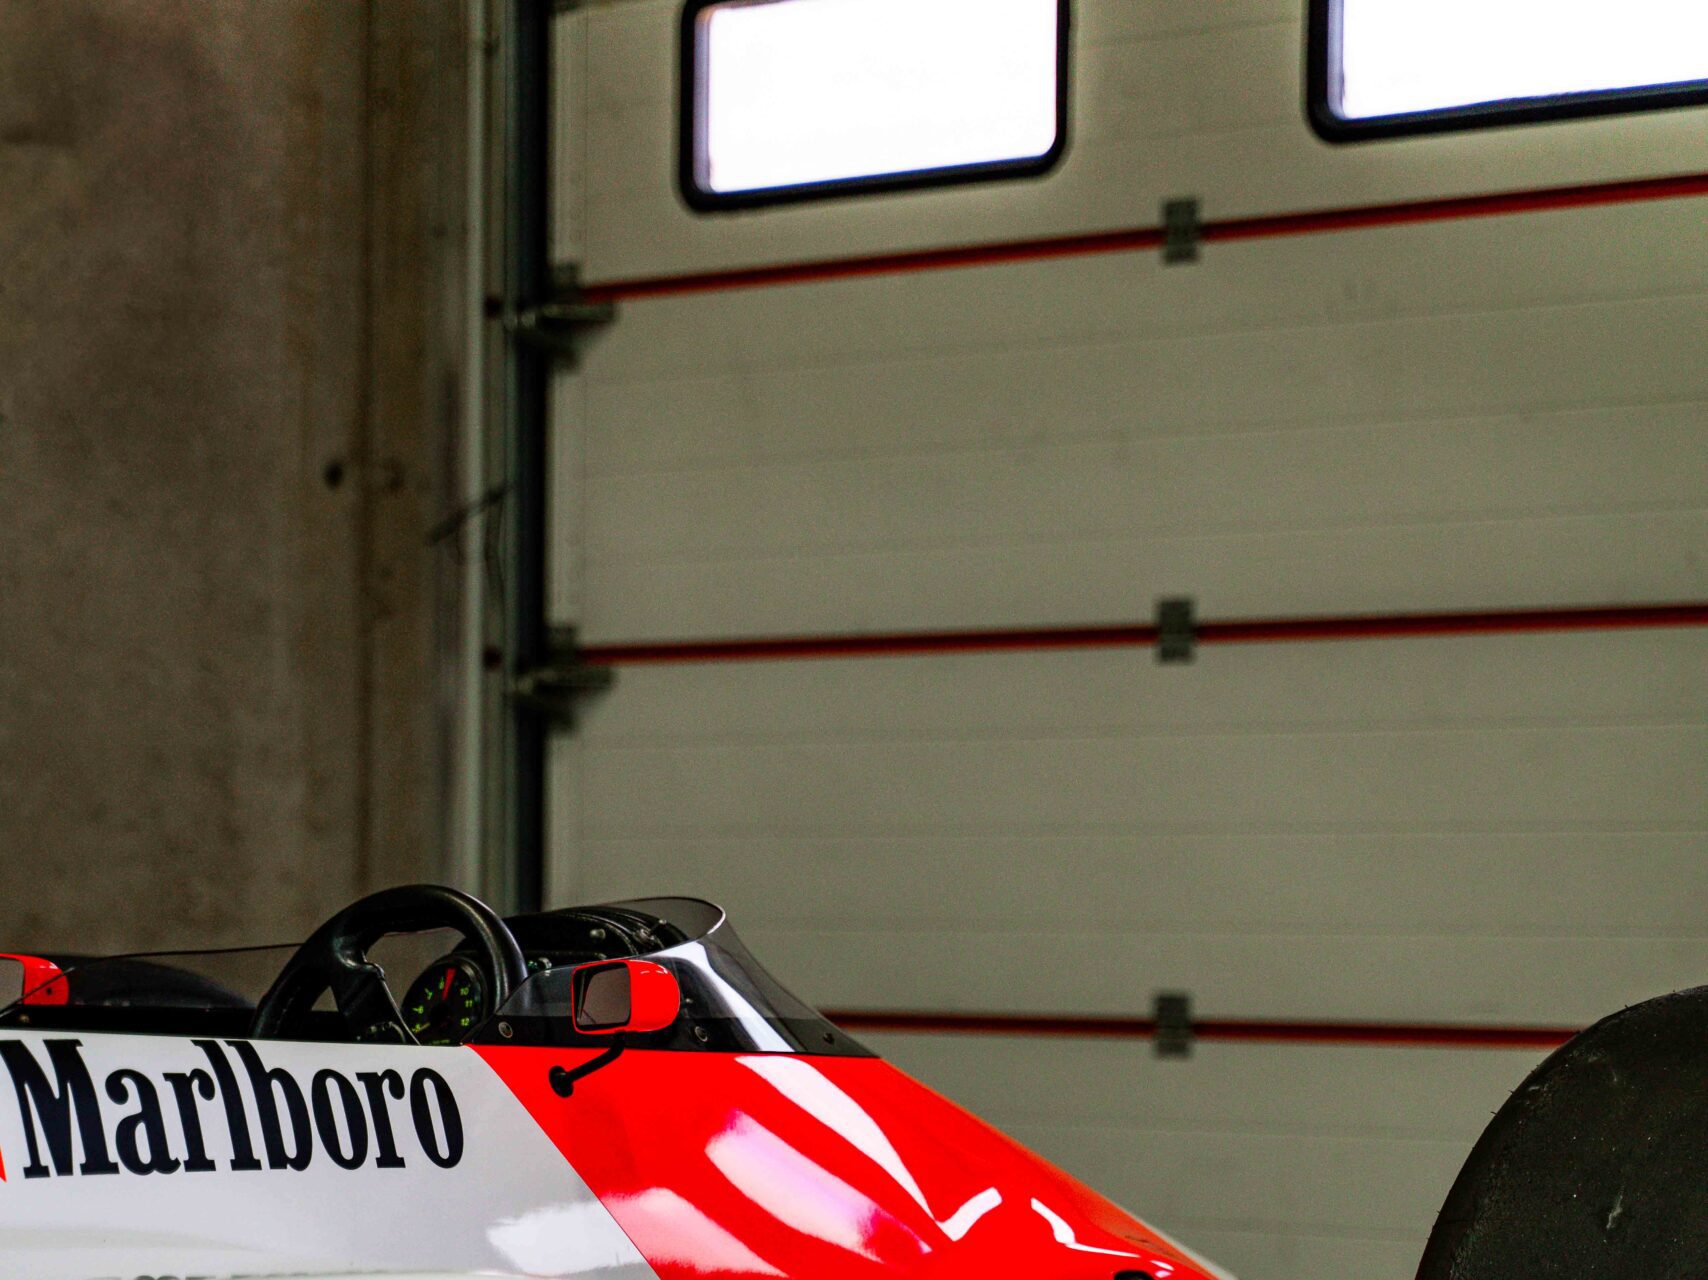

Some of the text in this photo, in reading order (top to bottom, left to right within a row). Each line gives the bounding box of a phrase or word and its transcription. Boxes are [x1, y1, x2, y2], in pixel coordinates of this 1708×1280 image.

[460, 987, 469, 996] 10
[465, 1000, 473, 1008] 11
[461, 1017, 470, 1026] 12
[0, 1038, 464, 1179] Marlboro
